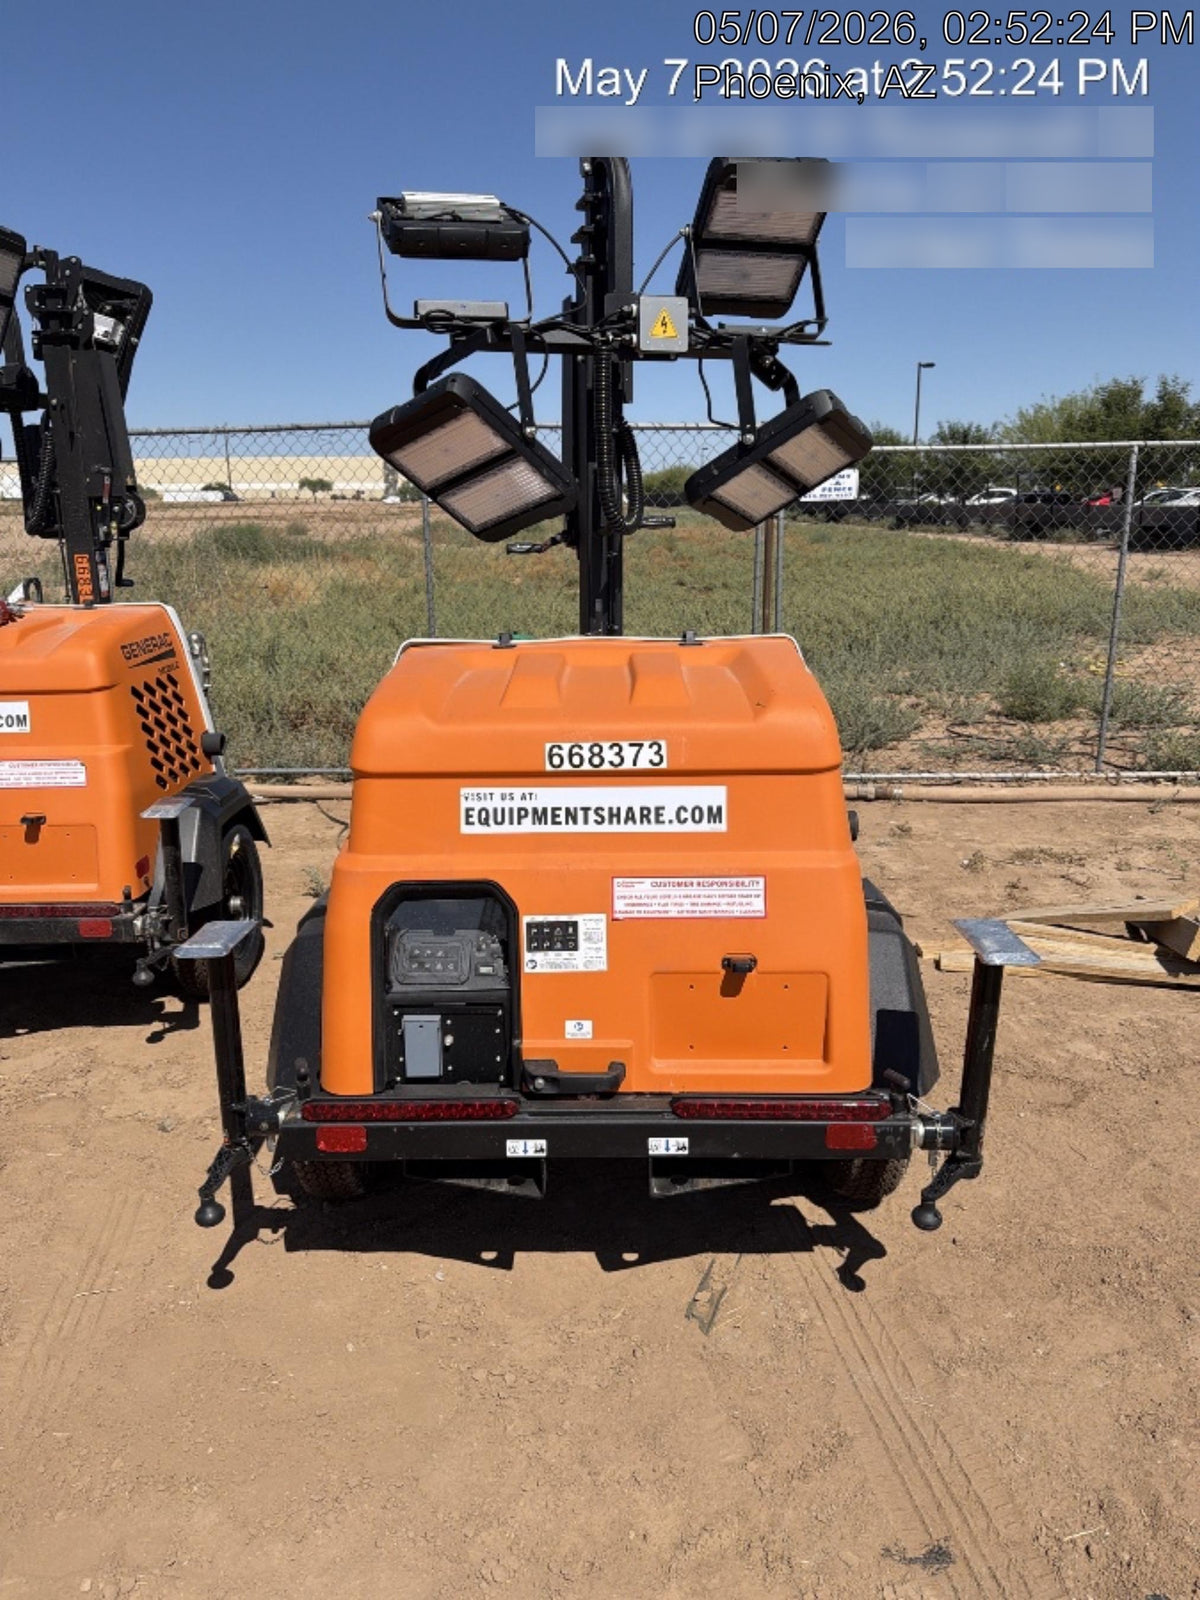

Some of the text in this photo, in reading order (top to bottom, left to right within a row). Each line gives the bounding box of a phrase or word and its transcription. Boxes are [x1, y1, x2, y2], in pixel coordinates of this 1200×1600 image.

[120, 632, 173, 660] GENERAC
[547, 741, 665, 769] 668373
[463, 792, 495, 802] VISIT
[500, 792, 515, 801] US
[464, 805, 723, 827] EQUIPMENTSHARE.COM
[650, 880, 694, 888] CUSTOMER
[696, 879, 760, 888] RESPONSIBILITY
